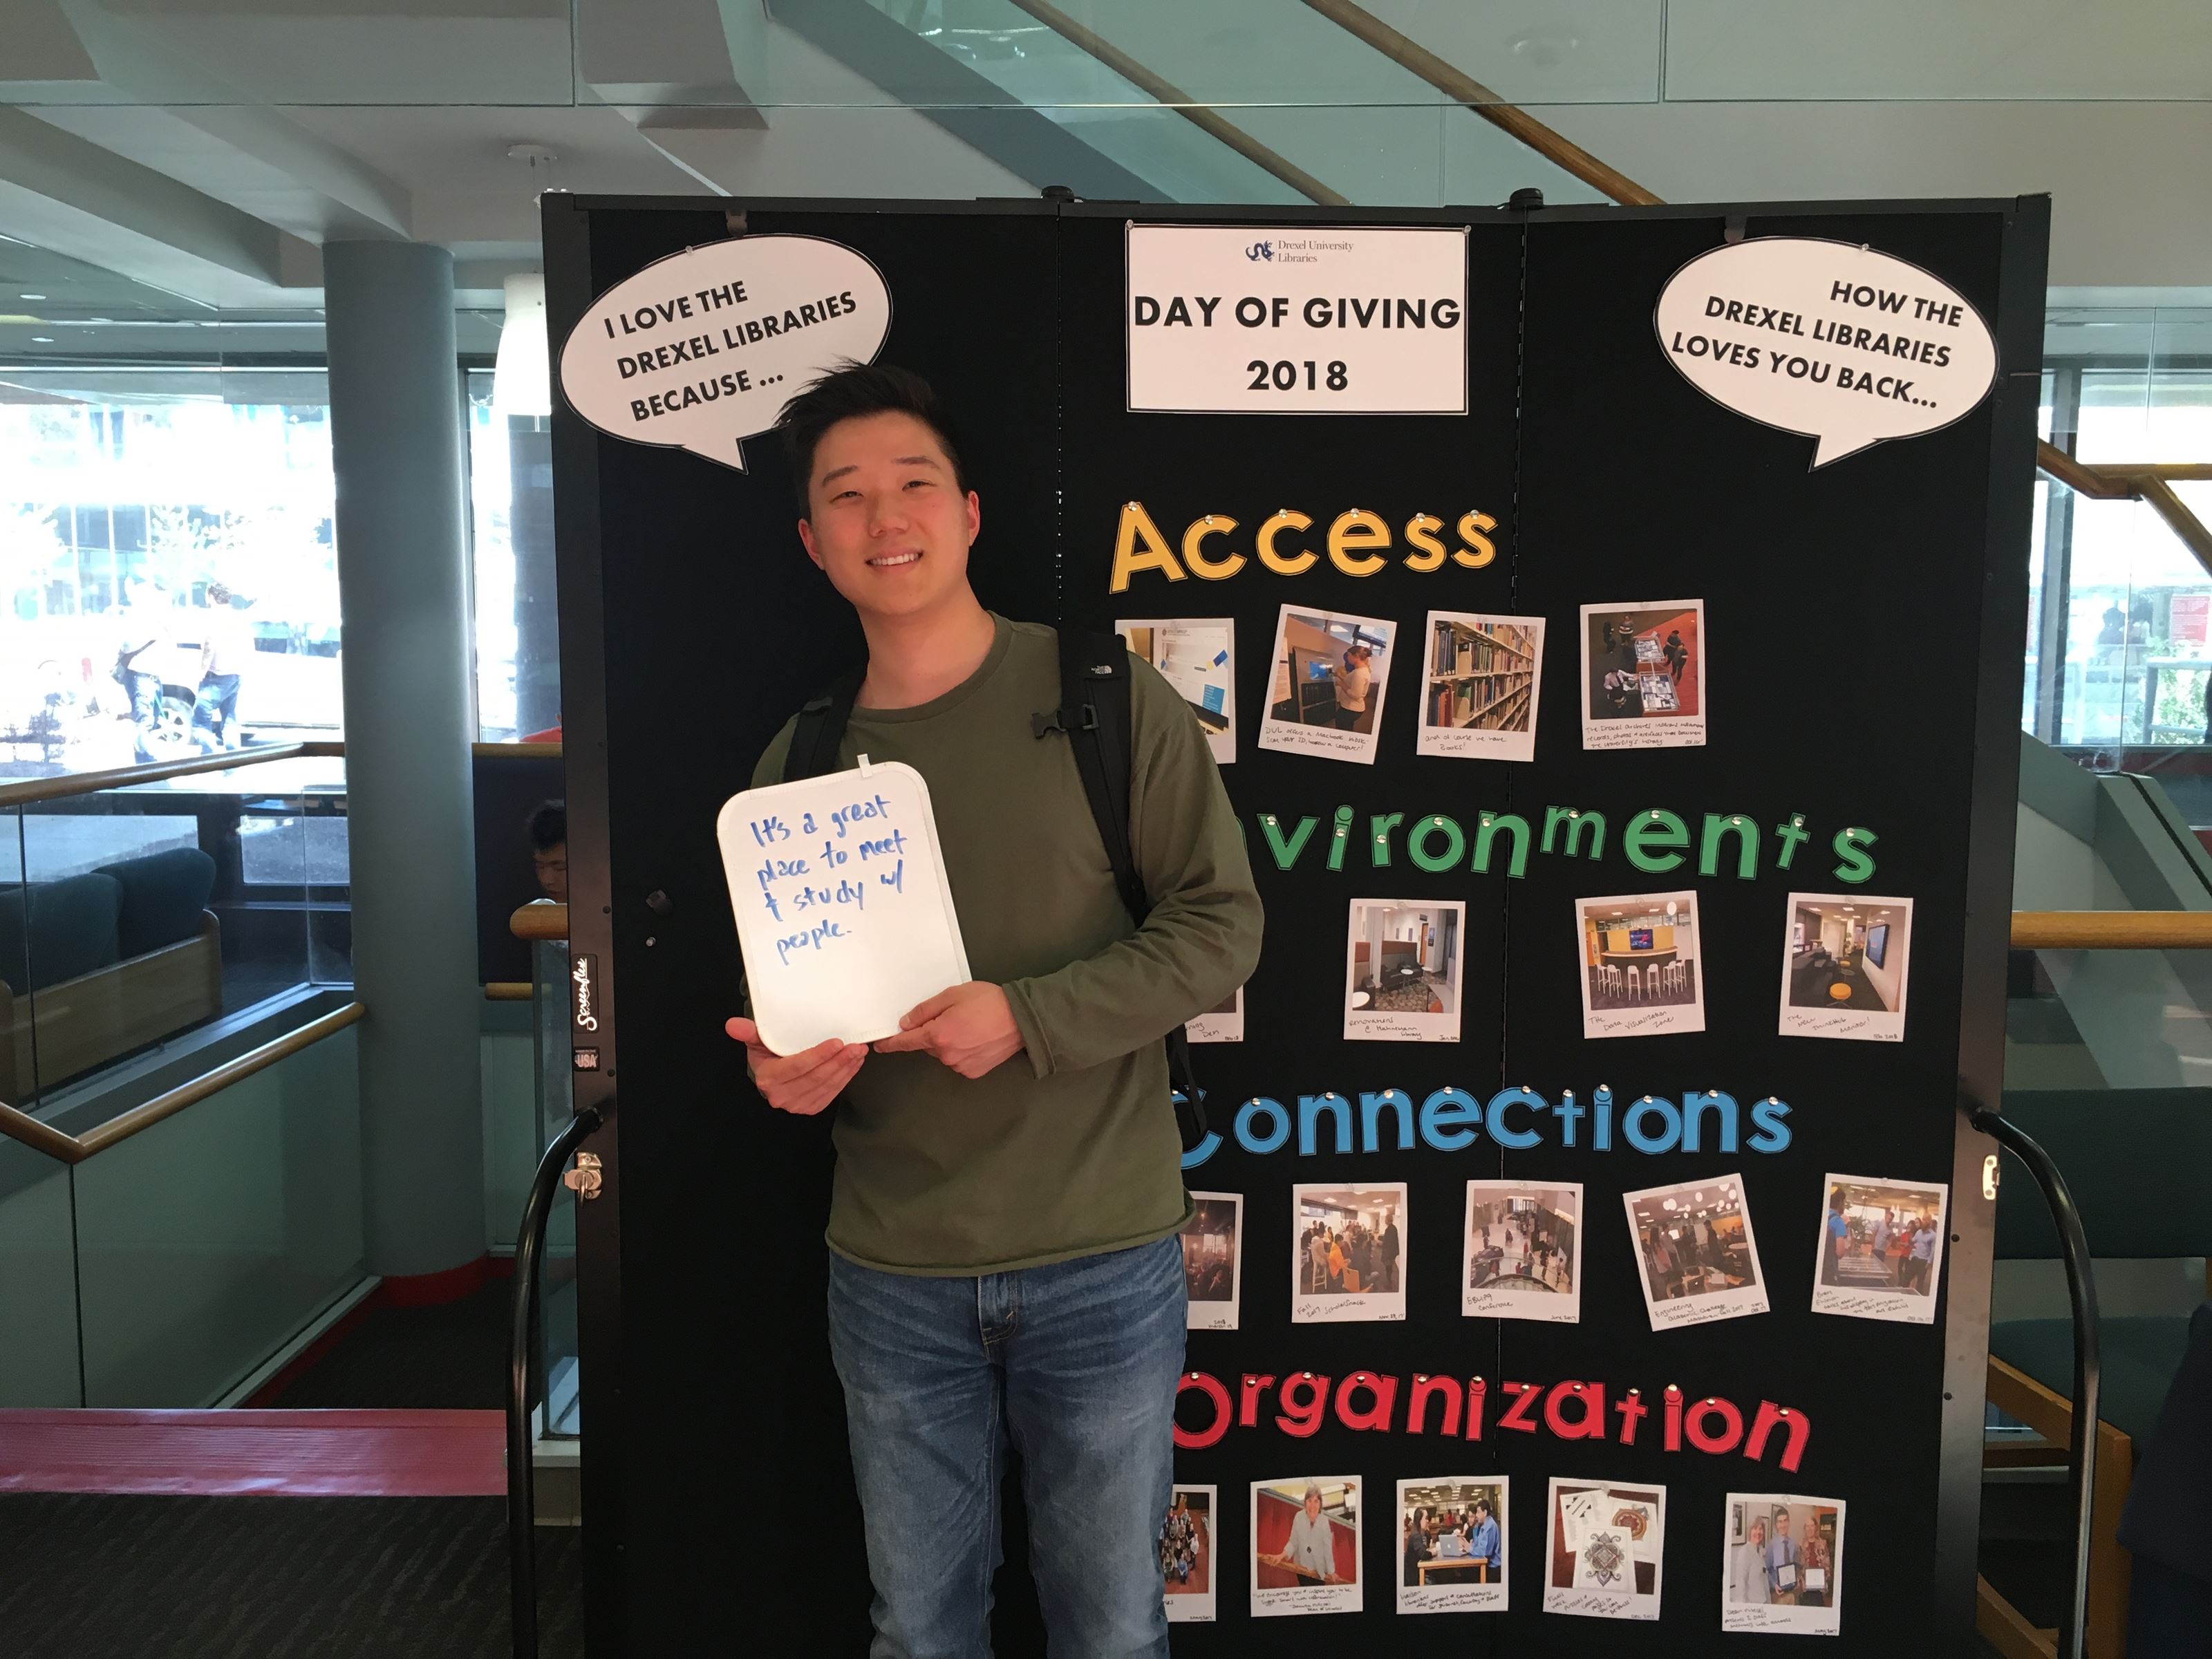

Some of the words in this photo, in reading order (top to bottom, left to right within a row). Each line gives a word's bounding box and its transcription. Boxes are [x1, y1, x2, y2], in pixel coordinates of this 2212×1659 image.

[1278, 240, 1306, 250] Drexel
[1309, 240, 1353, 252] University
[1278, 253, 1318, 263] Libraries
[604, 317, 615, 339] I
[619, 296, 693, 335] LOVE
[695, 280, 748, 312] THE
[1135, 296, 1222, 327] DAY
[1235, 297, 1289, 328] OF
[1303, 298, 1461, 329] GIVING
[1830, 280, 1908, 314] HOW
[1914, 297, 1964, 328] THE
[617, 334, 720, 379] DREXEL
[722, 290, 857, 350] LIBRARIES
[1704, 295, 1805, 337] DREXEL
[1812, 319, 1952, 368] LIBRARIES
[630, 369, 752, 422] BECAUSE
[1246, 360, 1348, 391] 2018
[1671, 331, 1761, 369] LOVES
[1770, 350, 1831, 383] YOU
[1836, 367, 1937, 409] BACK...
[1110, 501, 1498, 594] Access
[751, 816, 791, 847] It's
[803, 812, 818, 834] a
[831, 794, 891, 838] great
[1236, 805, 1878, 883] vironments
[757, 859, 810, 891] place
[820, 841, 848, 869] to
[859, 829, 908, 861] meet
[793, 879, 864, 911] study
[573, 958, 597, 1031] Screenflex
[1604, 1021, 1622, 1031] Data
[578, 1054, 597, 1068] USA
[1297, 1302, 1312, 1315] Fall
[1655, 1302, 1694, 1318] Engineering
[1173, 1371, 1811, 1472] Organization
